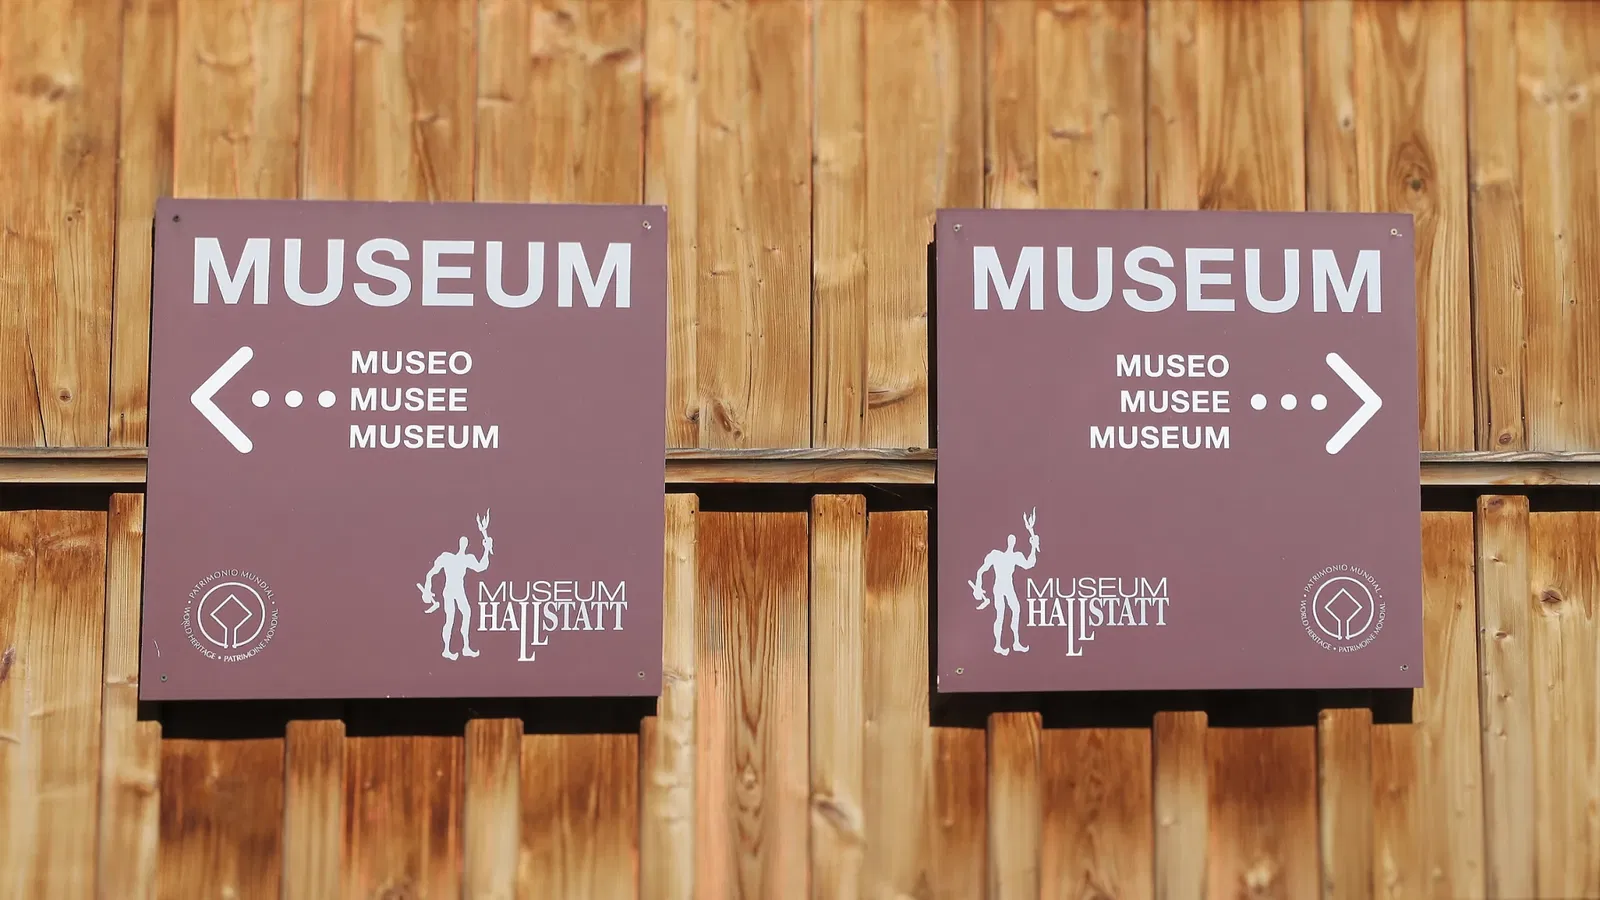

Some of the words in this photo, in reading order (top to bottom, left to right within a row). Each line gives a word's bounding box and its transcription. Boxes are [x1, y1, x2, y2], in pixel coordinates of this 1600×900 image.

[193, 236, 632, 309] MUSEUM
[973, 245, 1382, 314] MUSEUM
[351, 350, 473, 375] MUSEO
[1116, 353, 1230, 378] MUSEO
[350, 387, 468, 412] MUSEE
[1120, 389, 1231, 414] MUSEE
[349, 424, 499, 449] MUSEUM
[1090, 425, 1230, 450] MUSEUM
[189, 569, 239, 599] PATRIMONIO
[240, 570, 275, 600] MUNDIAL
[478, 580, 626, 602] MUSEUM
[1026, 577, 1167, 598] MUSEUM
[1304, 564, 1348, 593] PATRIMONIO
[1349, 565, 1381, 593] MUNDIAL
[181, 607, 193, 634] WORLD
[188, 635, 217, 660] HERITAGE
[223, 641, 266, 662] PATRIMOINE
[264, 608, 279, 644] MONDIAL
[477, 601, 628, 662] HALLSTATT
[1026, 597, 1170, 657] HALLSTATT
[1300, 600, 1309, 626] WORLD
[1305, 626, 1332, 651] HERITAGE
[1338, 633, 1376, 653] PATRIMOINE
[1373, 602, 1386, 636] MONDIAL
